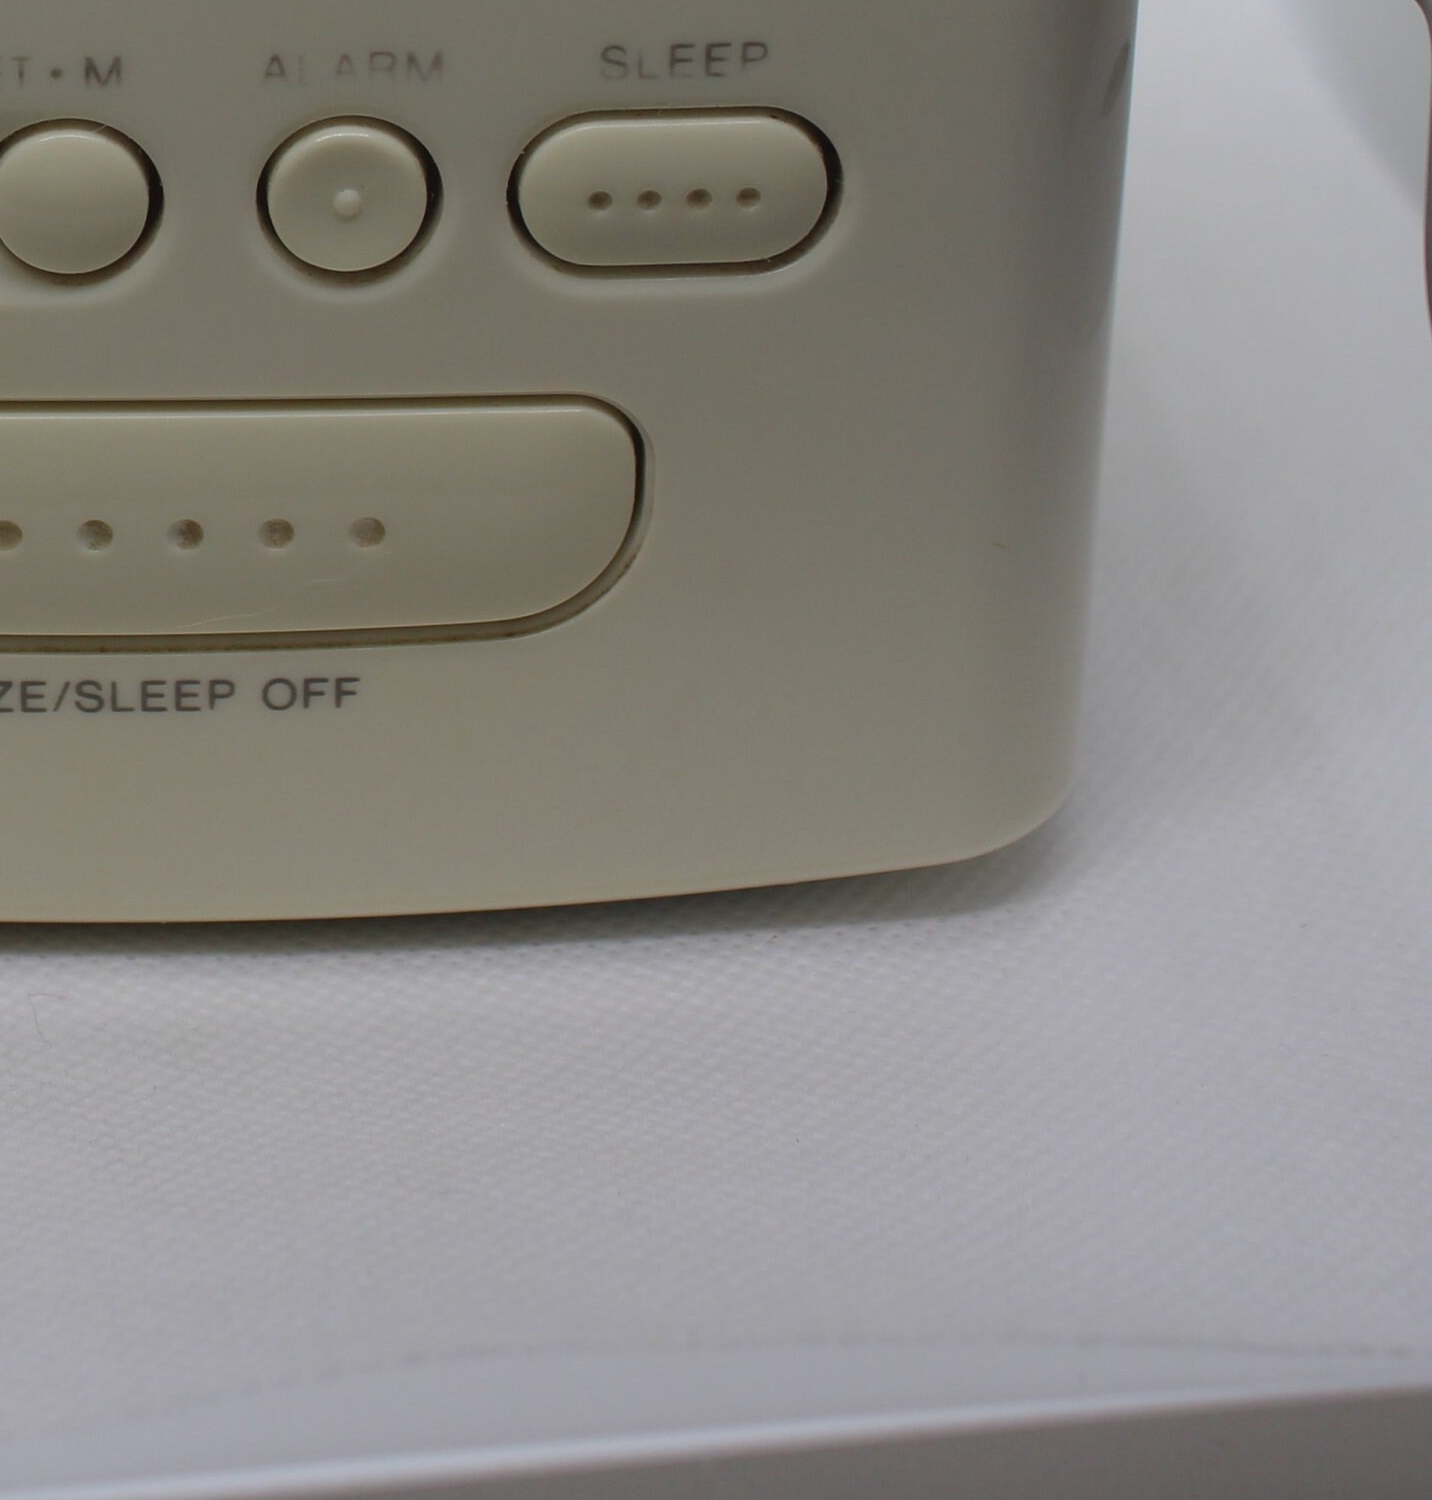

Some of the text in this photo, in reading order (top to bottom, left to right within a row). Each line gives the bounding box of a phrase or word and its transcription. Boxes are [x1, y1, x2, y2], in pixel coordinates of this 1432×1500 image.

[83, 56, 125, 88] M
[263, 50, 446, 88] ALARM
[600, 41, 770, 81] SLEEP
[262, 676, 361, 711] OFF
